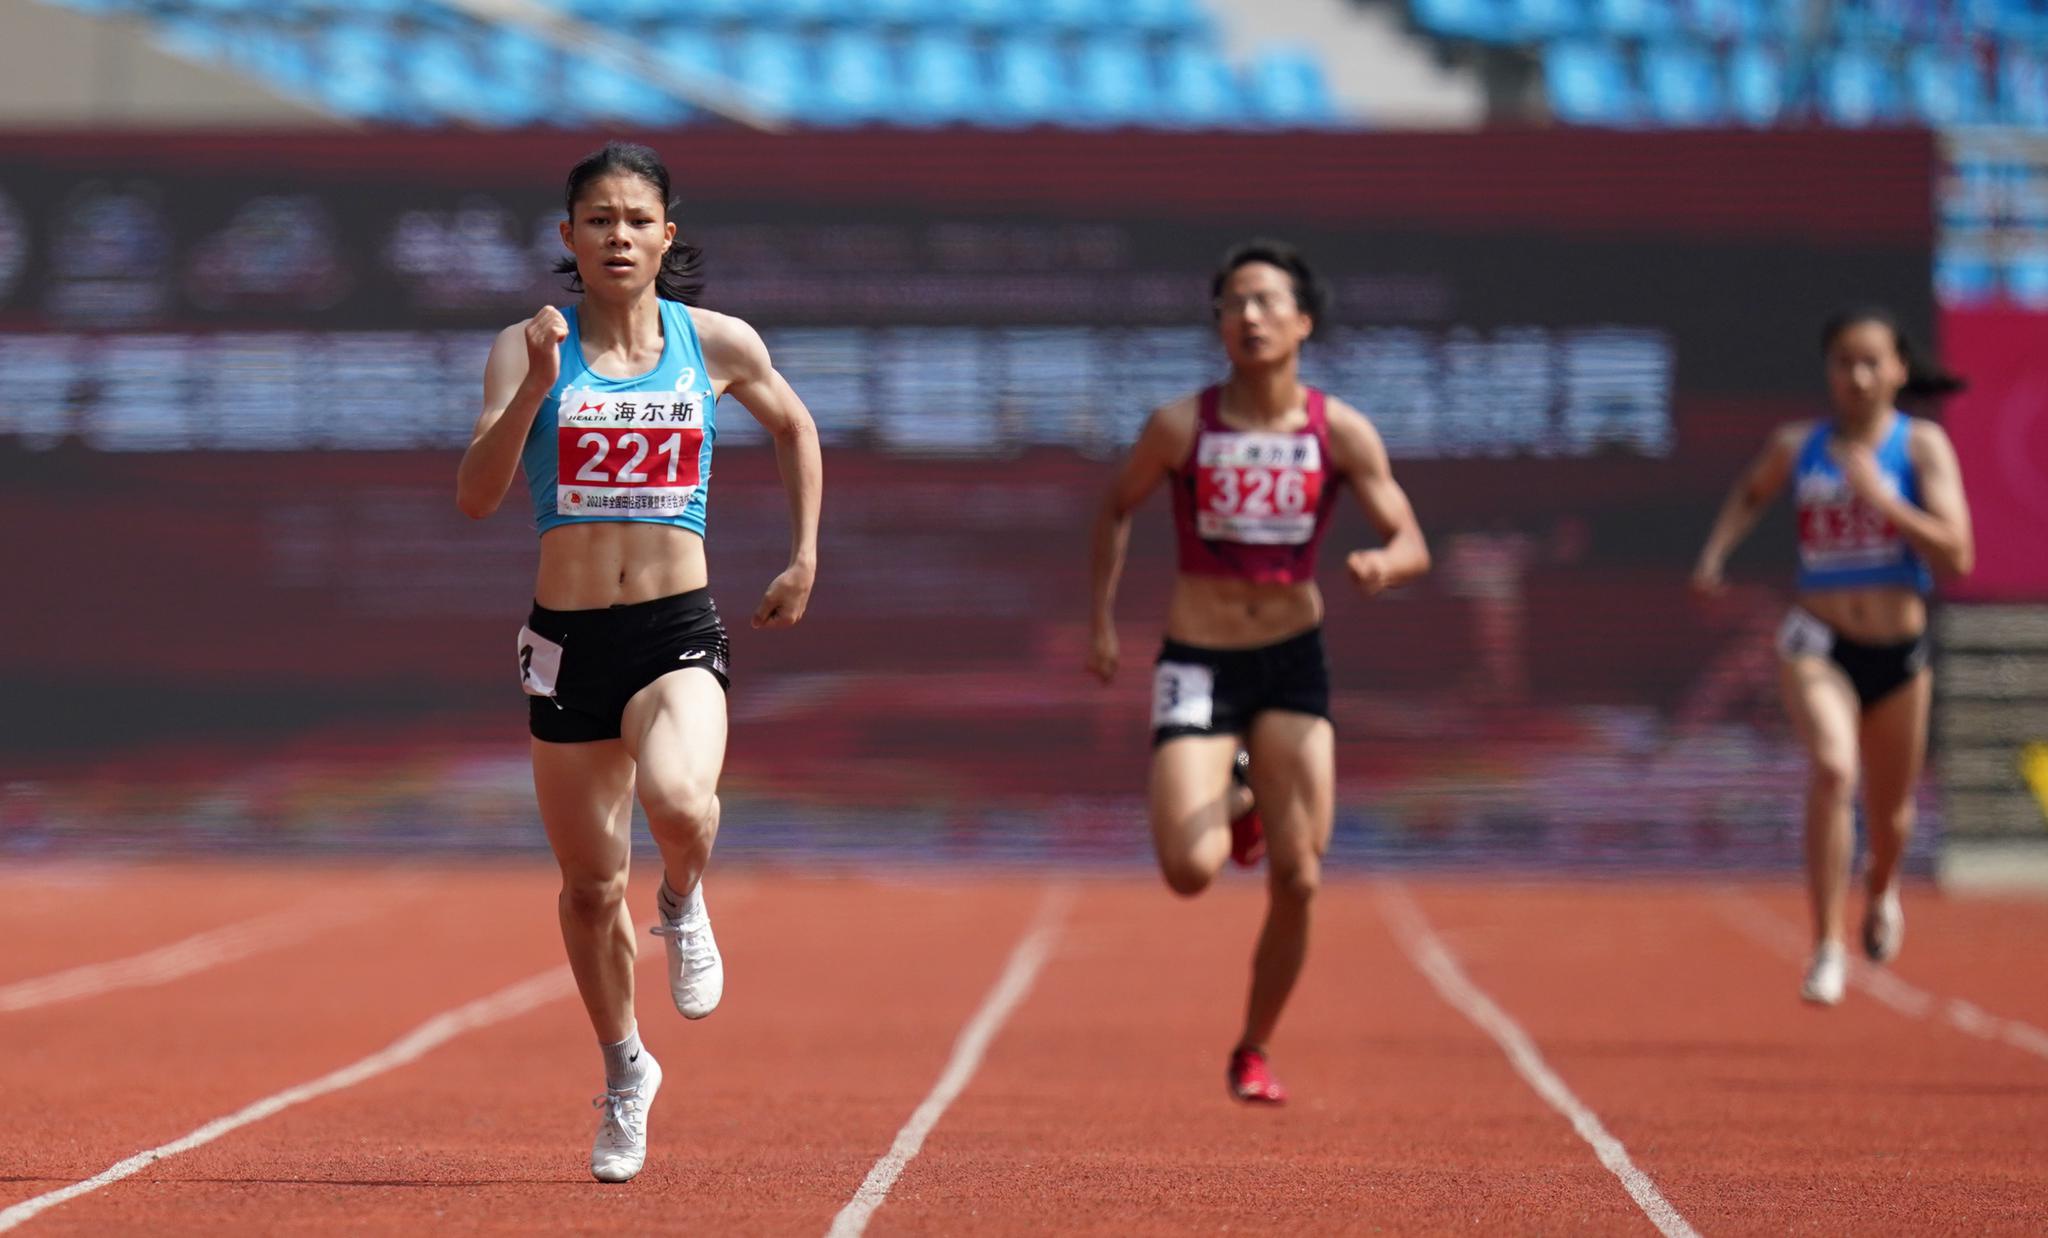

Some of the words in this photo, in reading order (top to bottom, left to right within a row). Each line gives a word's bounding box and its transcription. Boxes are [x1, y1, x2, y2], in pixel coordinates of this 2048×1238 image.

[614, 401, 693, 422] 海尔斯
[575, 432, 682, 483] 221
[1209, 467, 1307, 516] 326
